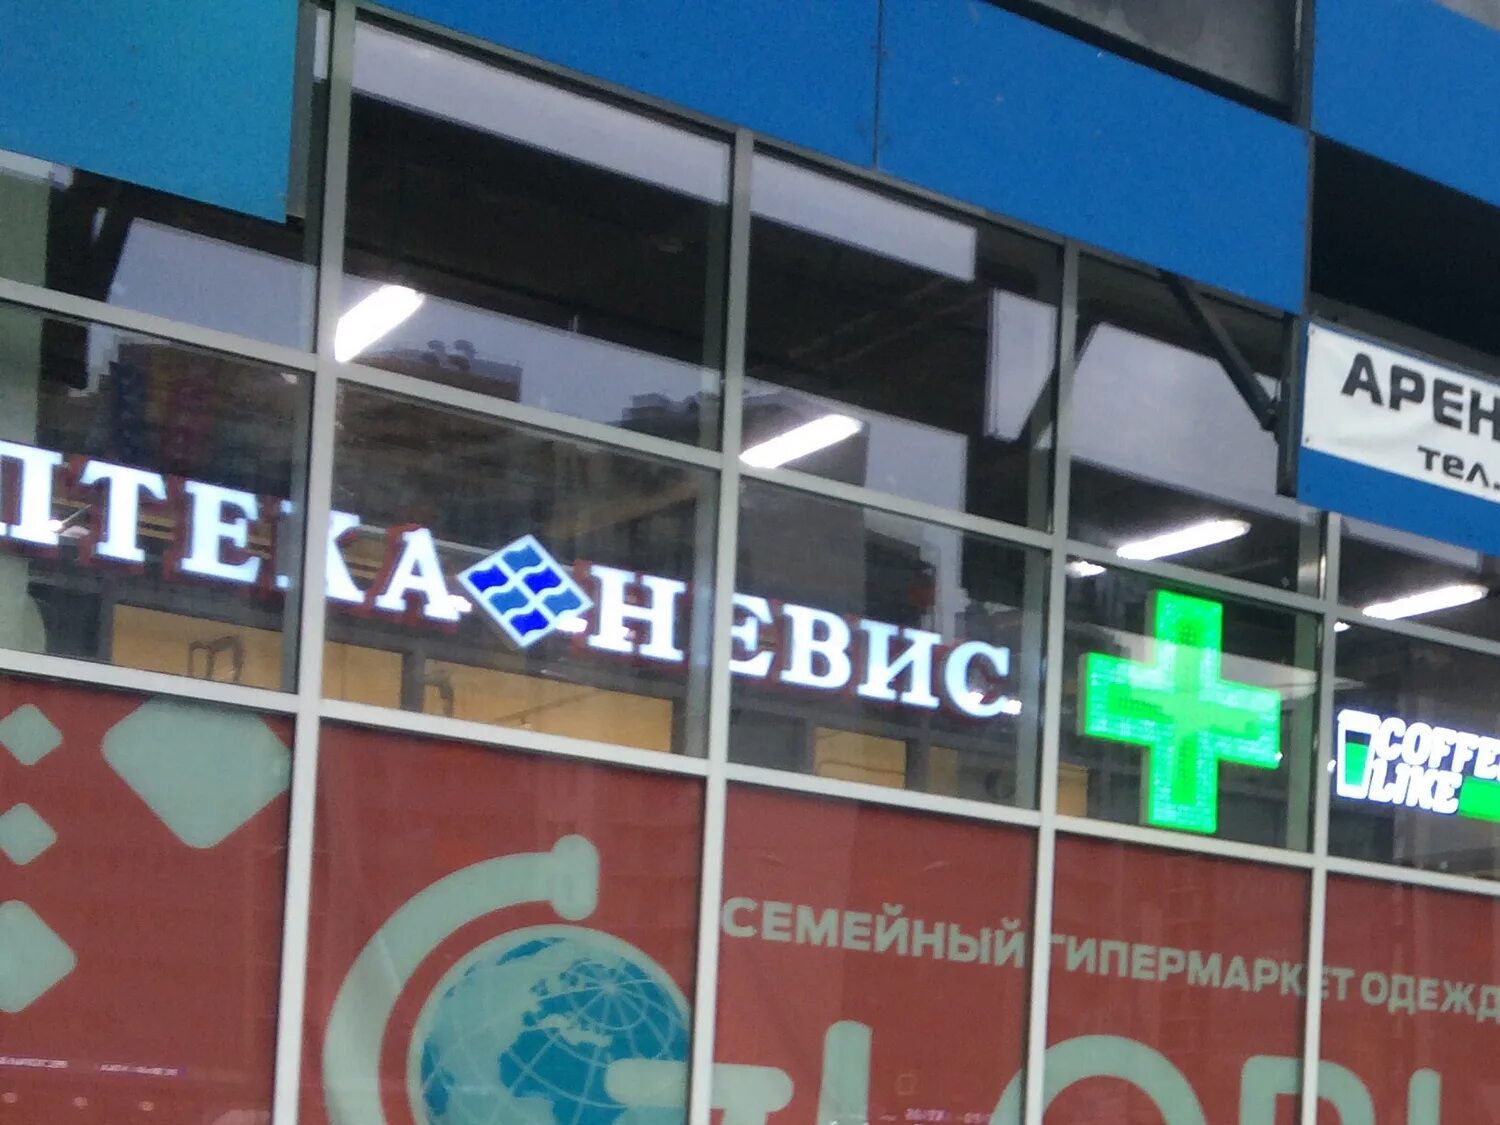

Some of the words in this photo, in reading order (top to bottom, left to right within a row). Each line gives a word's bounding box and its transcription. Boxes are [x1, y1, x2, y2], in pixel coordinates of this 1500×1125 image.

[586, 564, 1015, 718] НЕВИС
[1369, 757, 1464, 815] LIKE
[720, 896, 1026, 970] СЕМЕЙНЫЙ
